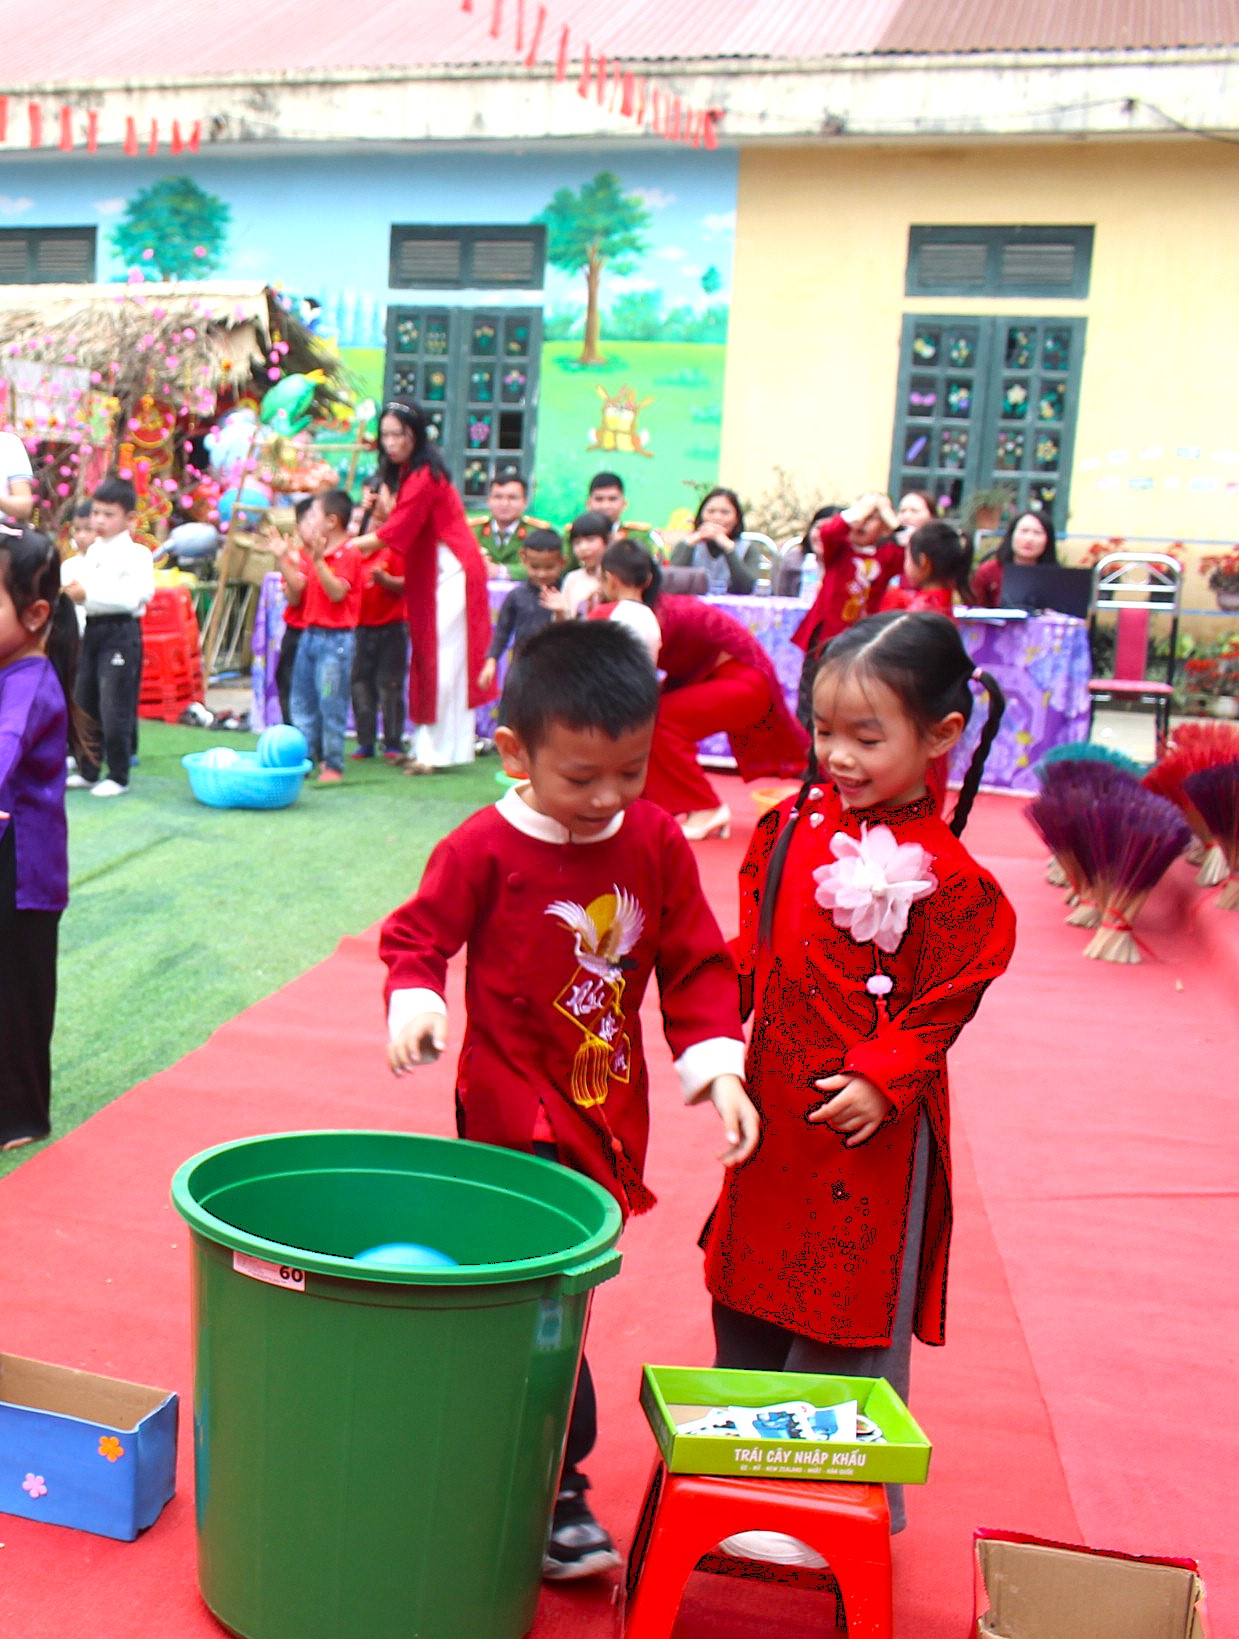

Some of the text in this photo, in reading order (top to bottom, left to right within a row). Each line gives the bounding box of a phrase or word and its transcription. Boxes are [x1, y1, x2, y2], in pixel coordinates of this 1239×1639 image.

[279, 1265, 303, 1283] 60
[734, 1446, 762, 1462] TRÁI
[766, 1447, 792, 1463] CÂY
[794, 1448, 829, 1466] NHẬP
